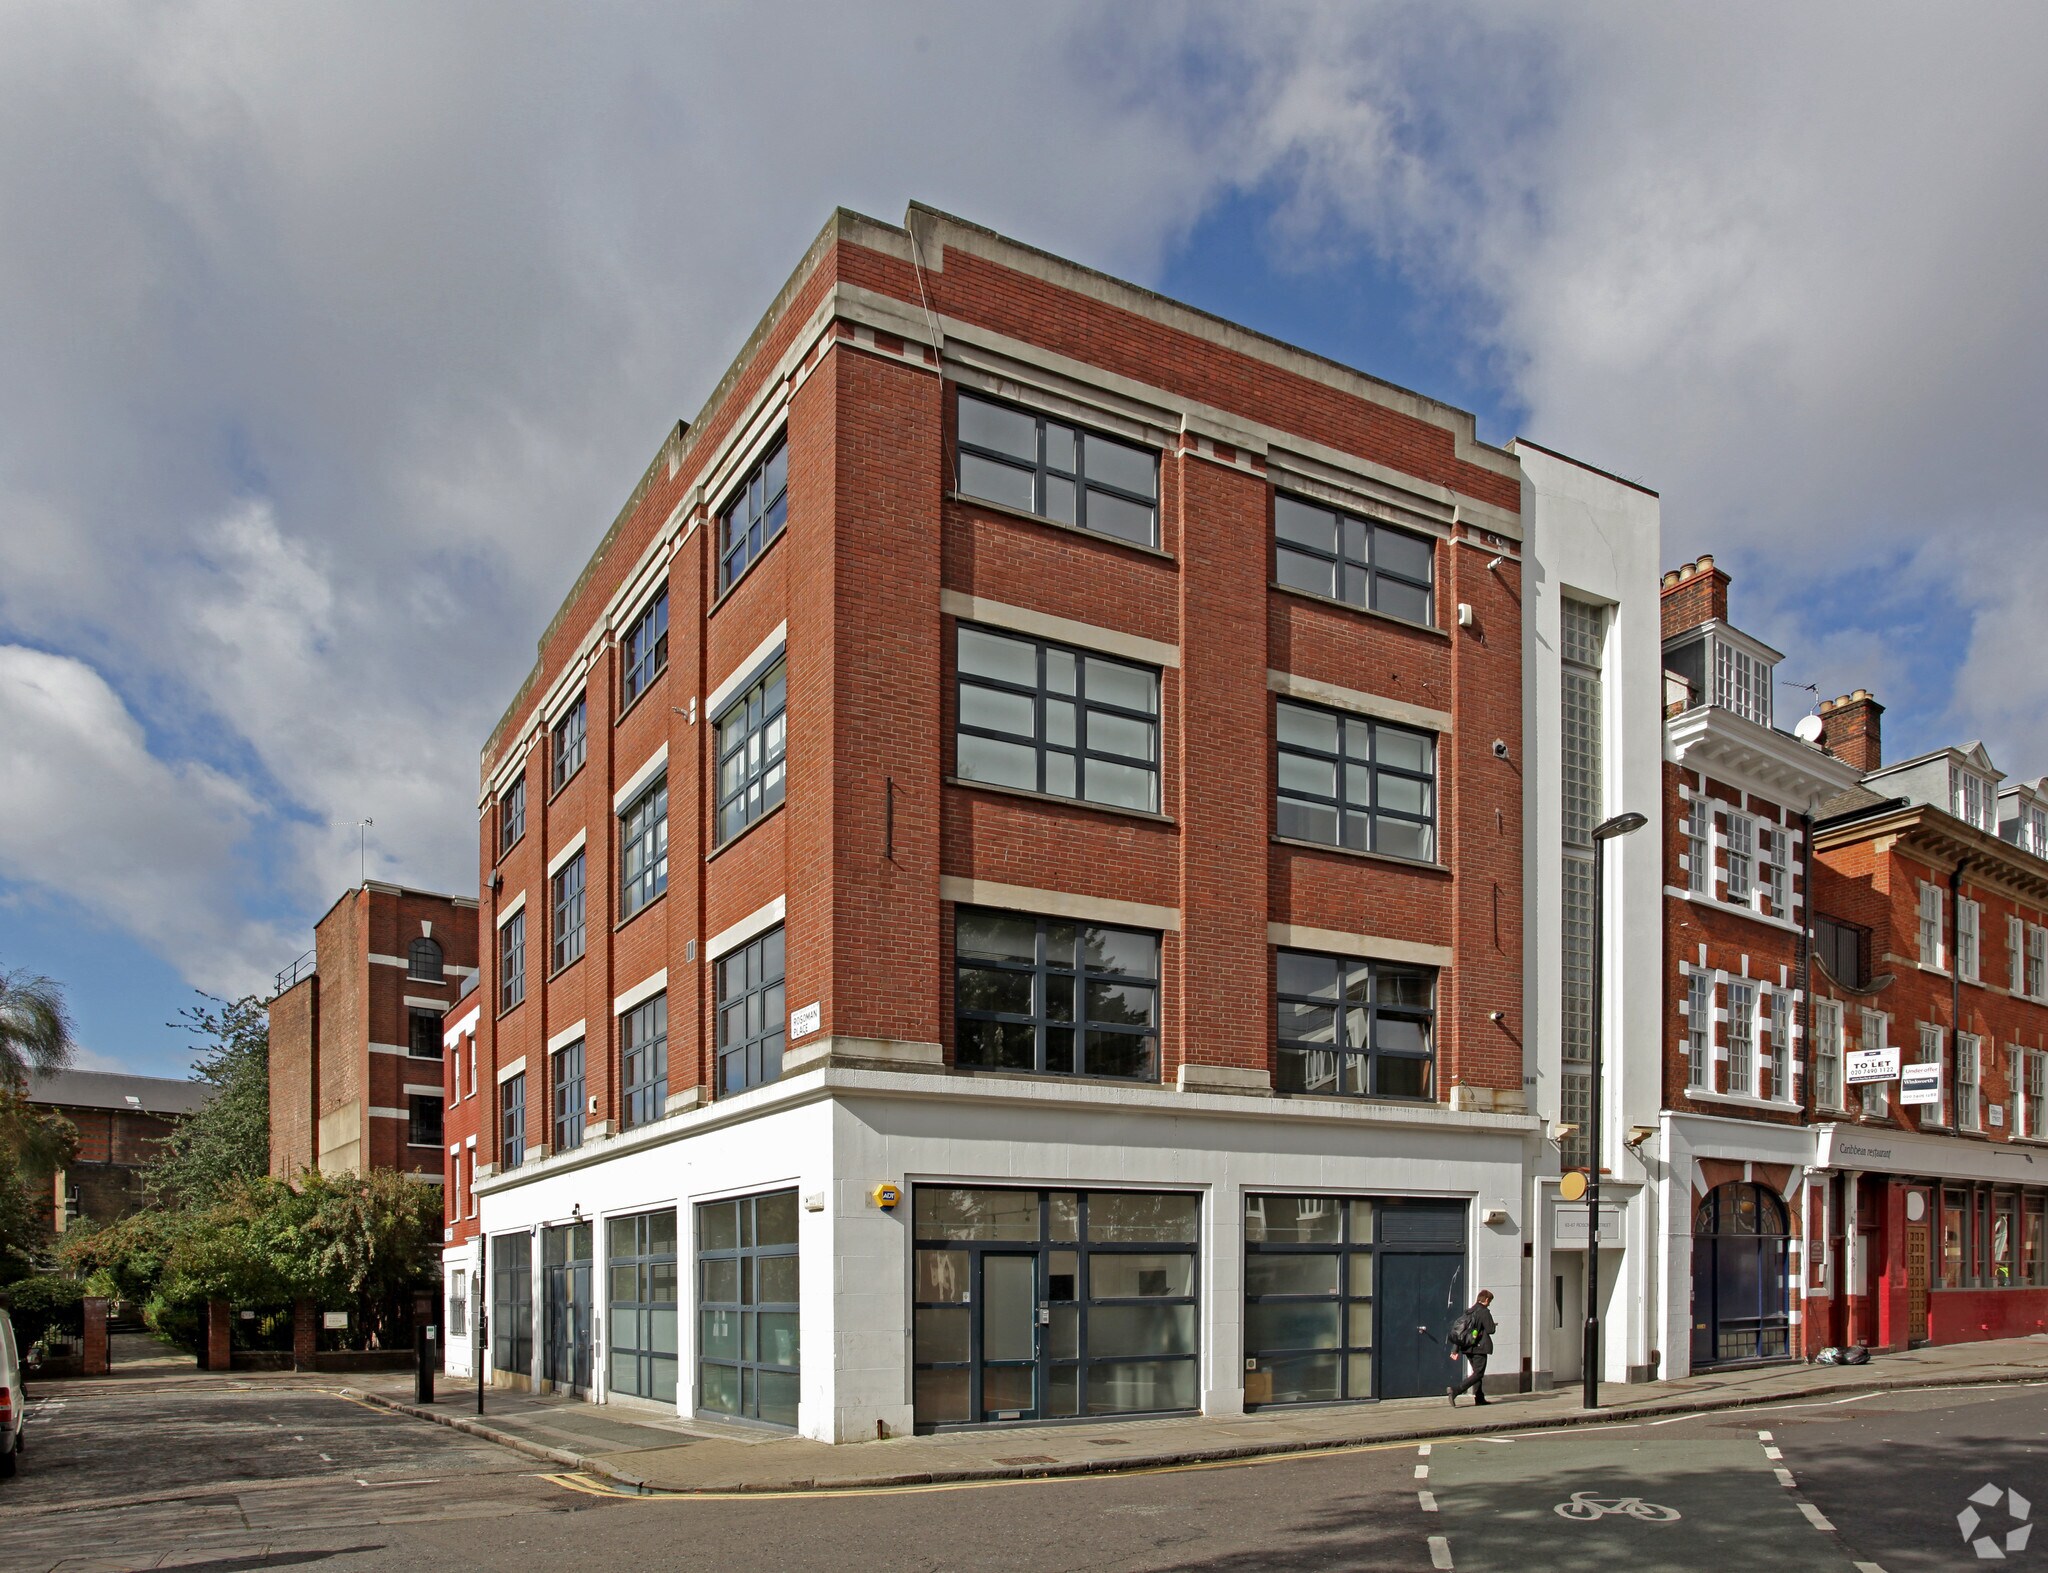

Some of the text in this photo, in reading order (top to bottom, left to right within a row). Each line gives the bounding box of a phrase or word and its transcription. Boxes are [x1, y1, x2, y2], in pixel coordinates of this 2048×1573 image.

[793, 1010, 818, 1024] ROSOMAN
[793, 1023, 808, 1037] PLACE
[1840, 1143, 1891, 1158] Caribbean restaurant
